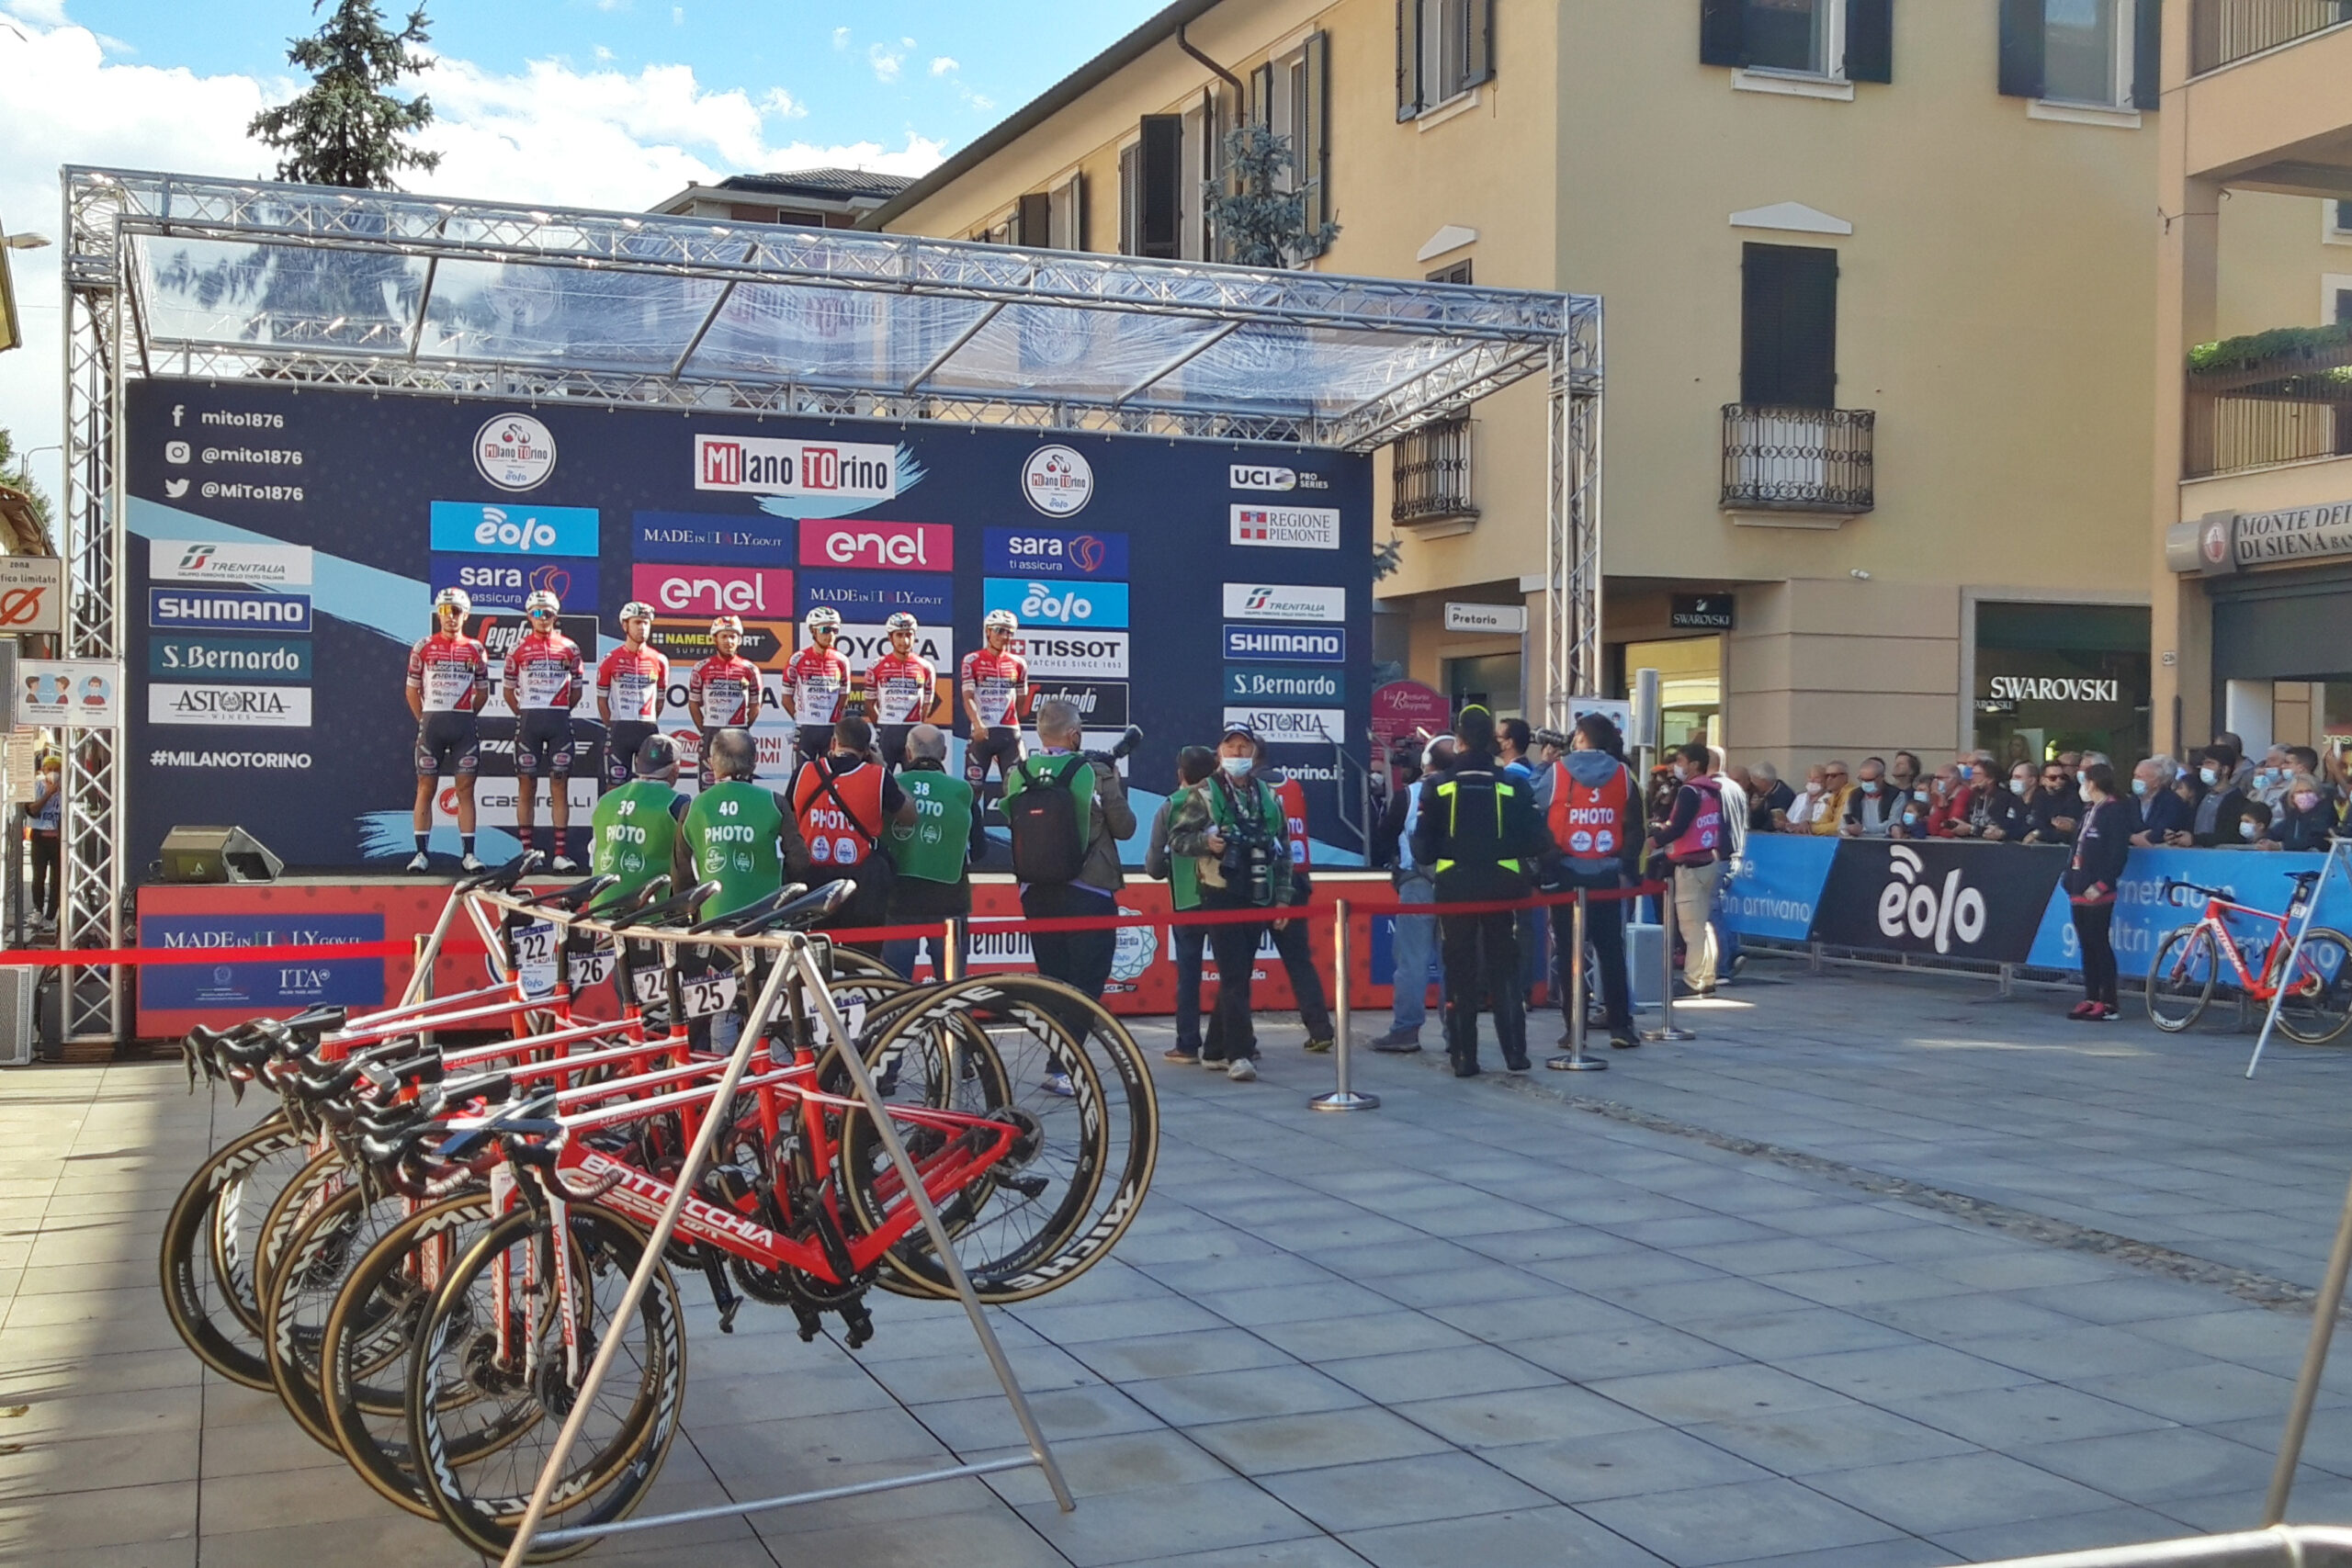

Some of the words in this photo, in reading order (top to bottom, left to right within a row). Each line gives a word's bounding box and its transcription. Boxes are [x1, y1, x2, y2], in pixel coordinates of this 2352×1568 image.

[201, 410, 284, 428] mito1876
[201, 446, 303, 466] @mito1876
[1235, 469, 1271, 485] UCI
[1299, 472, 1317, 480] PRO
[1300, 480, 1329, 489] SERIES
[201, 481, 304, 501] @MiTo1876
[1270, 513, 1330, 529] REGIONE
[2240, 510, 2310, 536] MONTE
[1270, 529, 1330, 543] PIEMONTE
[2240, 538, 2261, 559] DI
[2267, 531, 2327, 557] SIENA
[826, 527, 927, 565] enel
[1009, 536, 1063, 557] sara
[211, 562, 286, 573] TRENITALIA
[1010, 559, 1017, 569] ti
[1019, 560, 1063, 570] assicura
[20, 574, 57, 583] limitato
[460, 567, 522, 587] sara
[471, 592, 522, 604] assicura
[661, 573, 765, 612] enel
[158, 598, 303, 622] SHIMANO
[1269, 603, 1325, 612] TRENITALIA
[1453, 614, 1497, 625] Pretorio
[1673, 614, 1729, 626] SWAROVSKI
[1029, 640, 1121, 658] TISSOT
[1230, 633, 1339, 653] SHIMANO
[1990, 676, 2118, 702] SWAROVSKI
[175, 690, 287, 714] ASTORIA
[150, 750, 312, 769] #MILANOTORINO
[913, 782, 931, 795] 38
[617, 800, 636, 816] 39
[718, 801, 739, 816] 40
[1569, 807, 1614, 824] PHOTO
[606, 825, 646, 844] PHOTO
[705, 826, 754, 844] PHOTO
[1743, 889, 1810, 922] arrivano
[524, 934, 548, 960] 22
[279, 969, 322, 987] ITA
[580, 958, 604, 984] 26
[695, 981, 725, 1013] 25
[209, 1130, 322, 1192] MICH
